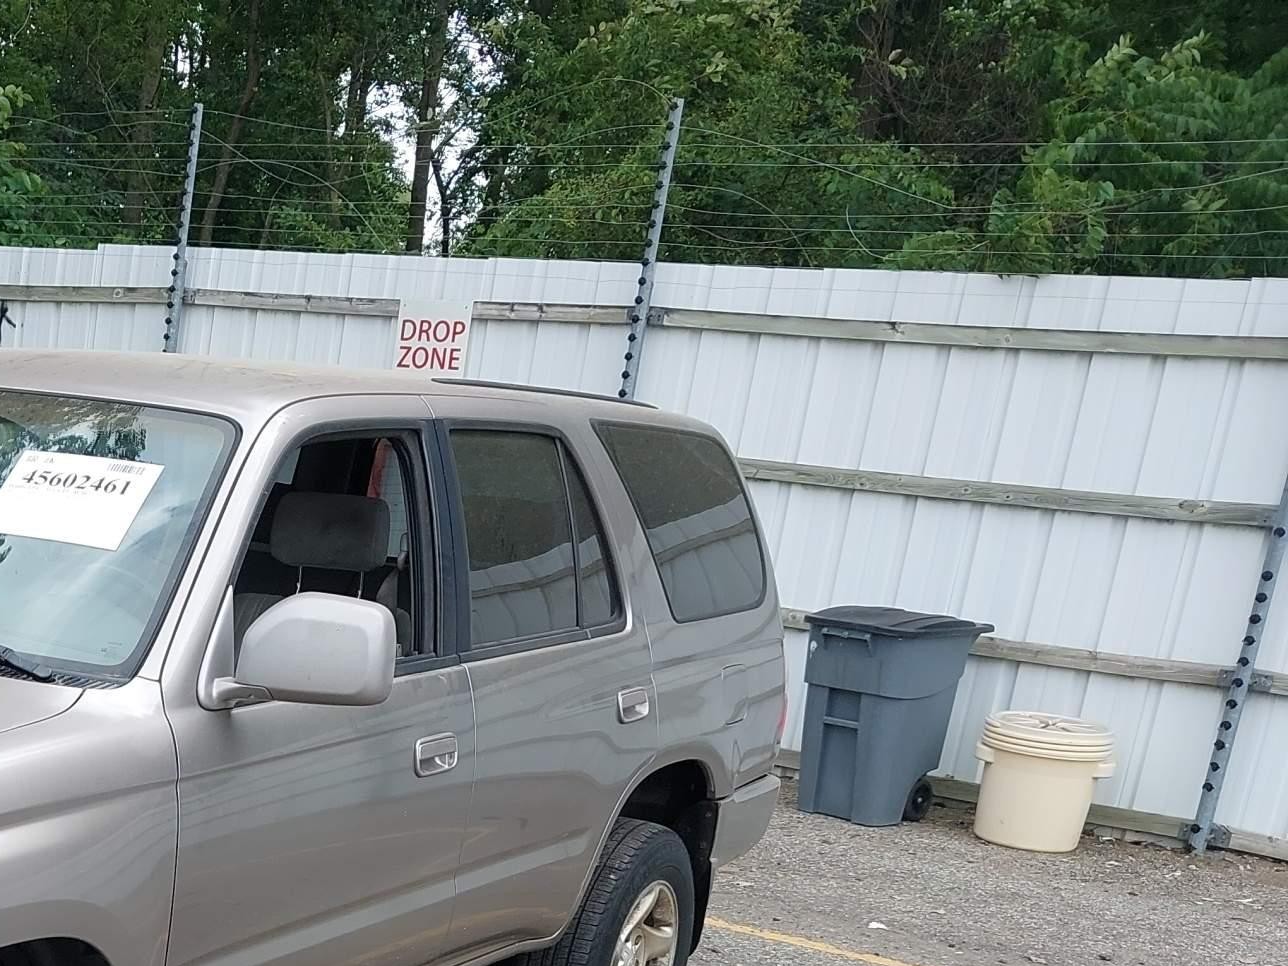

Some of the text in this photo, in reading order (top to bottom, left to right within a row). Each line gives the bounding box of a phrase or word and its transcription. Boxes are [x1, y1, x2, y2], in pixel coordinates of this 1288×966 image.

[400, 319, 466, 343] DROP
[396, 345, 462, 371] ZONE
[22, 468, 132, 496] 45602461
